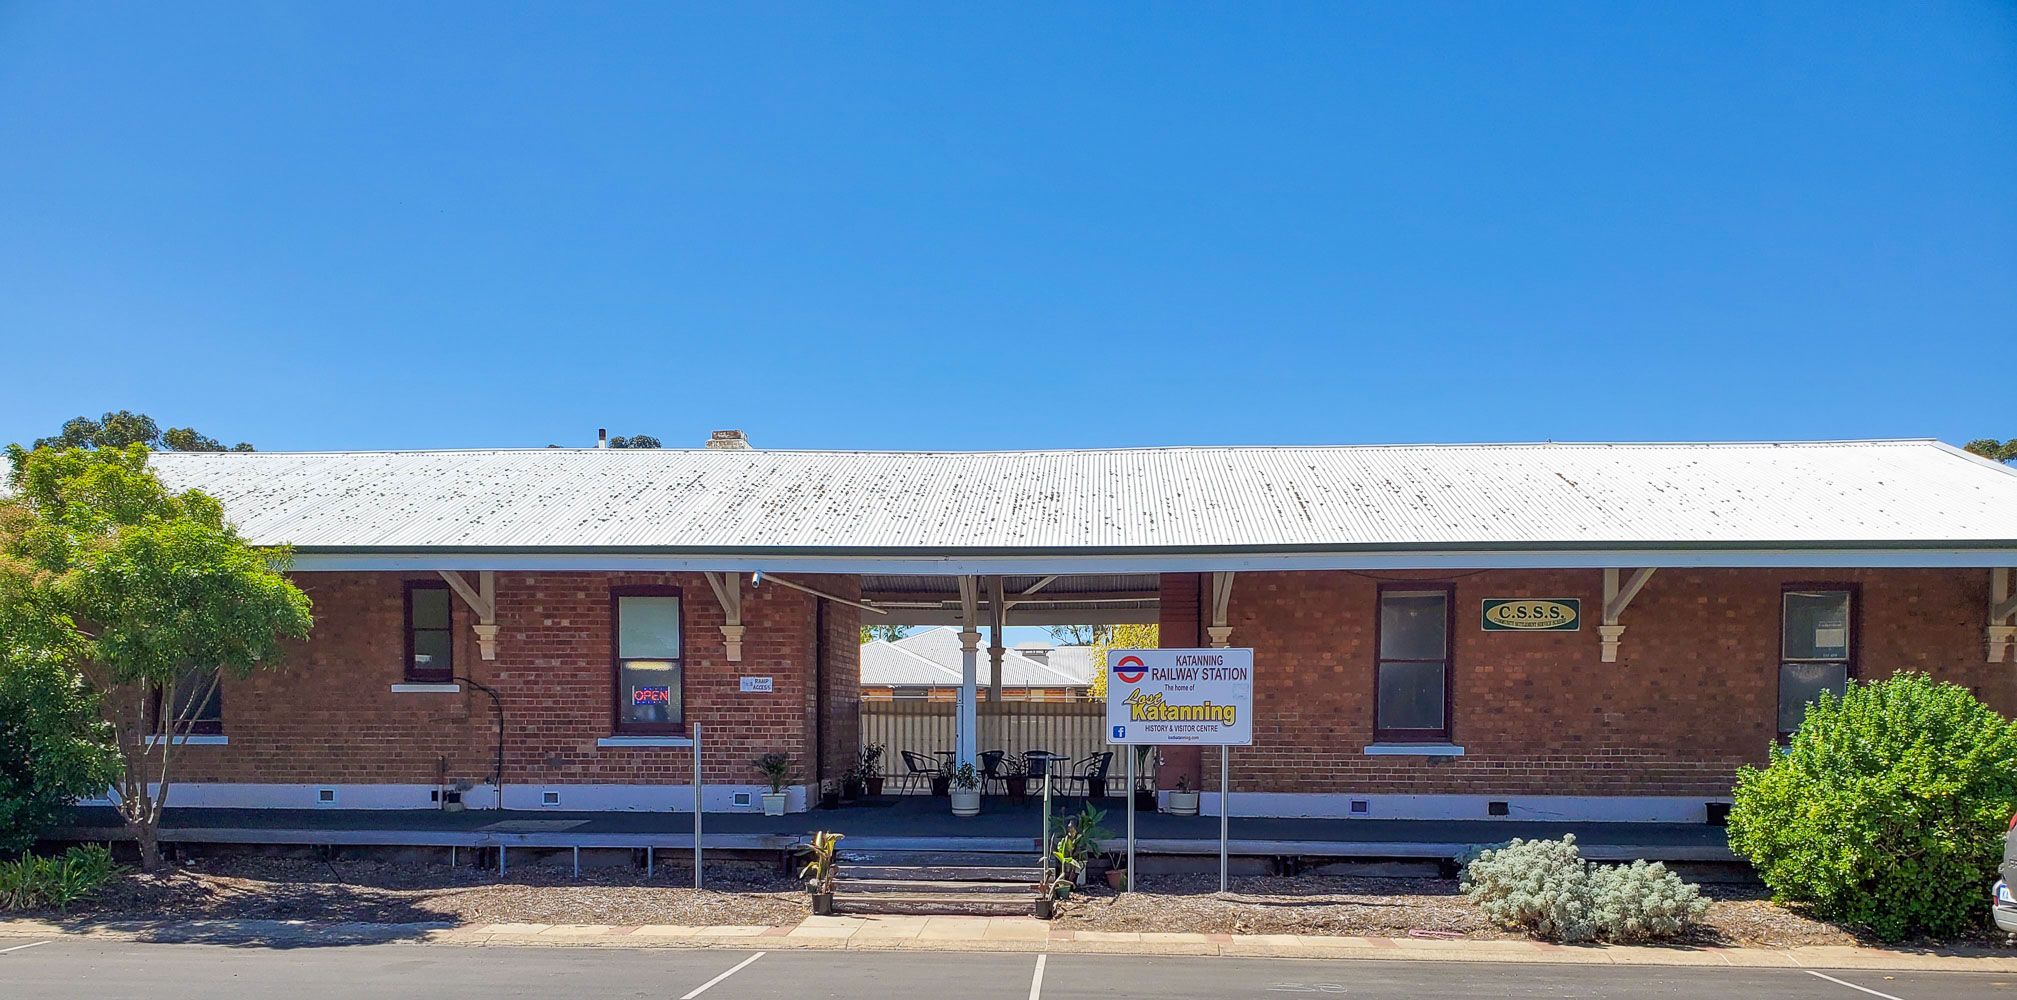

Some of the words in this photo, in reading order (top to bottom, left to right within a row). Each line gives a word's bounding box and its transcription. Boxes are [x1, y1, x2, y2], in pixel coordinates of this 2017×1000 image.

[1499, 606, 1565, 619] C.S.S.S.
[1176, 655, 1224, 666] KATANNING
[1152, 667, 1199, 681] RAILWAY
[1202, 667, 1247, 681] STATION
[634, 690, 668, 701] OPEN
[1122, 688, 1163, 706] Lost
[1130, 700, 1236, 727] Katanning
